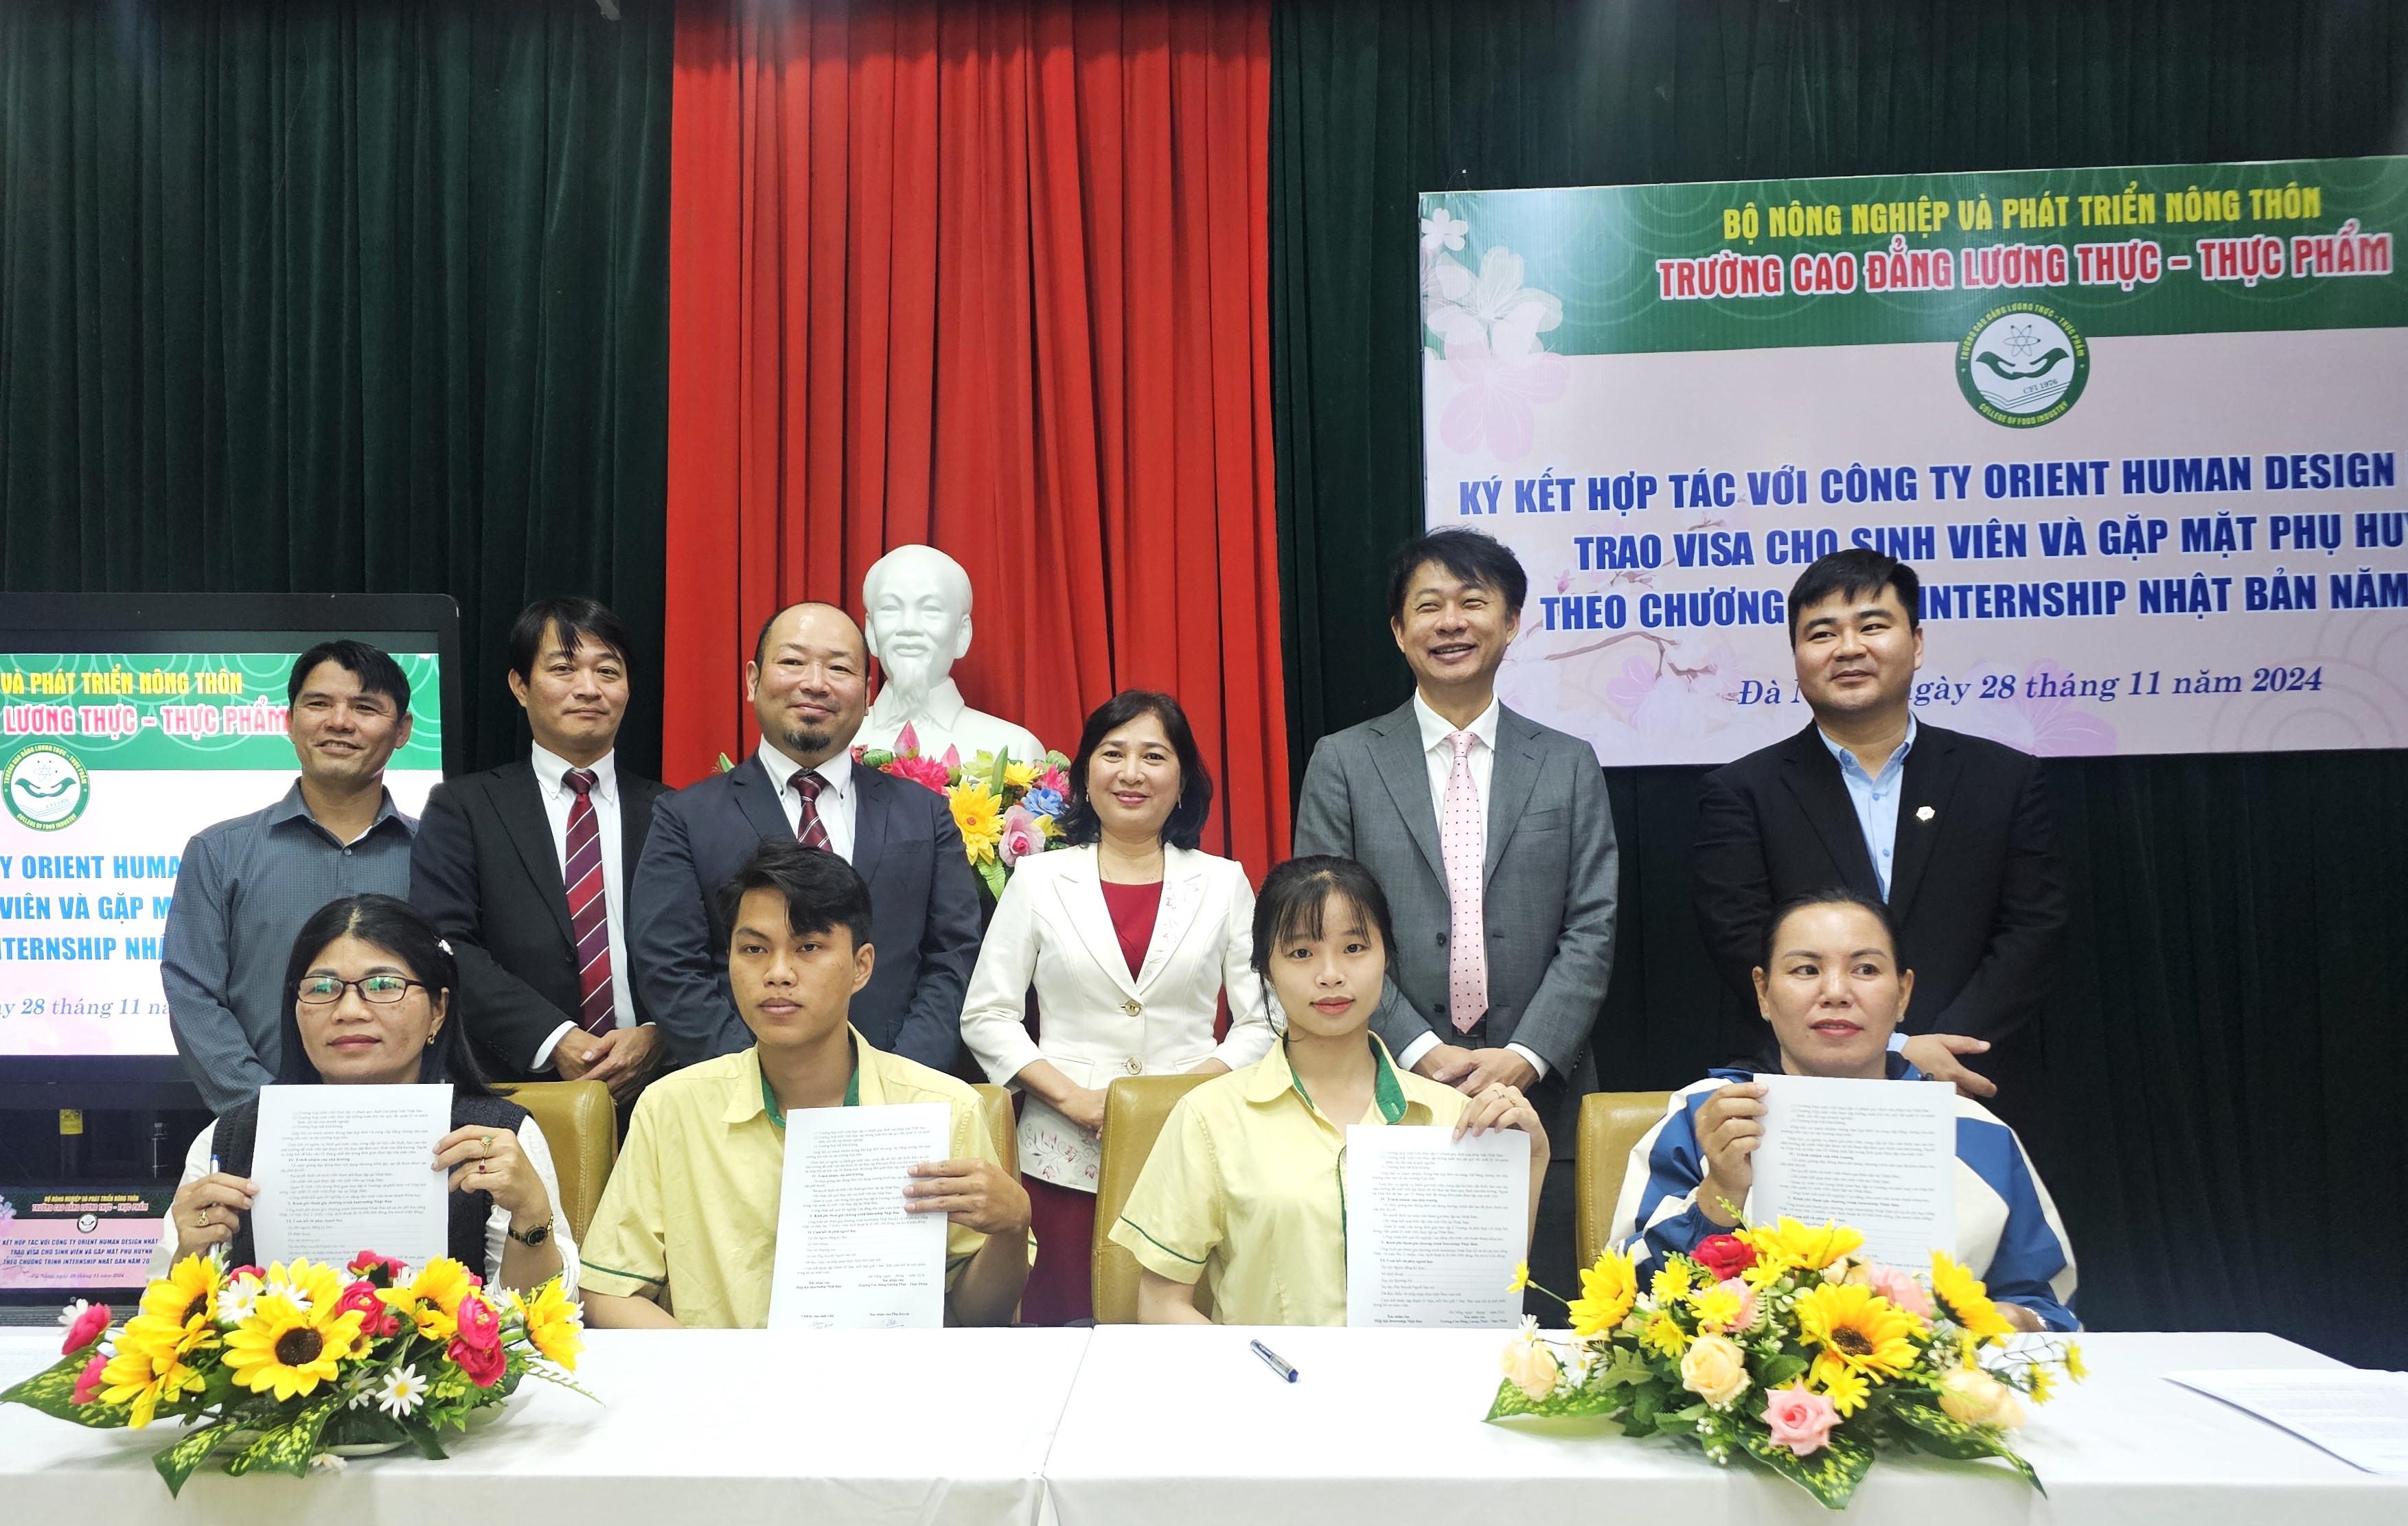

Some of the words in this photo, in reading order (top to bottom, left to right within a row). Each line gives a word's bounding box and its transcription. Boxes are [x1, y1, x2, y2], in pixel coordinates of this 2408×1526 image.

[1725, 202, 1758, 245] BỘ
[1769, 200, 1841, 236] NÔNG
[1853, 195, 1949, 238] NGHIỆP
[1960, 193, 1990, 231] VÀ
[2004, 190, 2068, 229] PHÁT
[2079, 180, 2155, 225] TRIỂN
[2166, 185, 2240, 222] NÔNG
[2250, 181, 2320, 220] THÔN
[1661, 255, 1780, 298] TRƯỜNG
[1796, 254, 1853, 290] CAO
[1868, 236, 1948, 288] ĐẲNG
[1967, 244, 2064, 286] LƯƠNG
[2078, 242, 2157, 288] THỰC
[2201, 238, 2280, 286] THỰC
[2296, 221, 2387, 273] PHẨM
[1461, 474, 1501, 514] KÝ
[1516, 467, 1575, 512] KẾT
[1589, 470, 1657, 518] HỢP
[1669, 467, 1734, 507] TÁC
[1748, 465, 1807, 505] VỚI
[1822, 463, 1916, 503] CÔNG
[1930, 466, 1971, 499] TY
[1985, 461, 2109, 498] ORIENT
[2123, 457, 2251, 494] HUMAN
[2266, 453, 2394, 489] DESIGN
[1574, 535, 1661, 570] TRAO
[1674, 531, 1754, 567] VISA
[1767, 529, 1837, 564] CHO
[1852, 526, 1934, 560] SINH
[1948, 518, 2026, 558] VIÊN
[2039, 517, 2086, 556] VÀ
[2099, 515, 2168, 560] GẶP
[2182, 512, 2256, 557] MẶT
[2271, 515, 2341, 555] PHỤ
[2355, 512, 2408, 547] HU
[1541, 595, 1626, 630] THEO
[1640, 588, 1784, 625] CHƯƠNG
[1919, 581, 2126, 620] INTERNSHIP
[2140, 573, 2232, 619] NHẬT
[2245, 568, 2316, 610] BẢN
[2330, 567, 2408, 609] NĂM
[1, 668, 25, 695] VÀ
[30, 668, 76, 695] PHÁT
[81, 663, 133, 695] TRIỂN
[139, 668, 190, 695] NÔNG
[194, 668, 242, 695] THÔN
[1739, 680, 1780, 704] Đà
[1908, 675, 1971, 706] gày
[1980, 675, 2015, 699] 28
[2026, 670, 2120, 702] tháng
[2130, 671, 2159, 695] 11
[2172, 669, 2241, 693] năm
[2251, 667, 2321, 691] 2024
[5, 706, 73, 732] LƯƠNG
[81, 706, 135, 737] THỰC
[163, 706, 216, 737] THỰC
[225, 697, 289, 732] PHẨM
[22, 855, 104, 879] ORIENT
[113, 856, 182, 879] HUMA
[0, 892, 50, 919] VIÊN
[58, 893, 90, 919] VÀ
[98, 892, 144, 924] GẶP
[0, 937, 116, 960] TERNSHIP
[21, 998, 45, 1015] 28
[52, 998, 113, 1019] tháng
[119, 998, 140, 1015] 11
